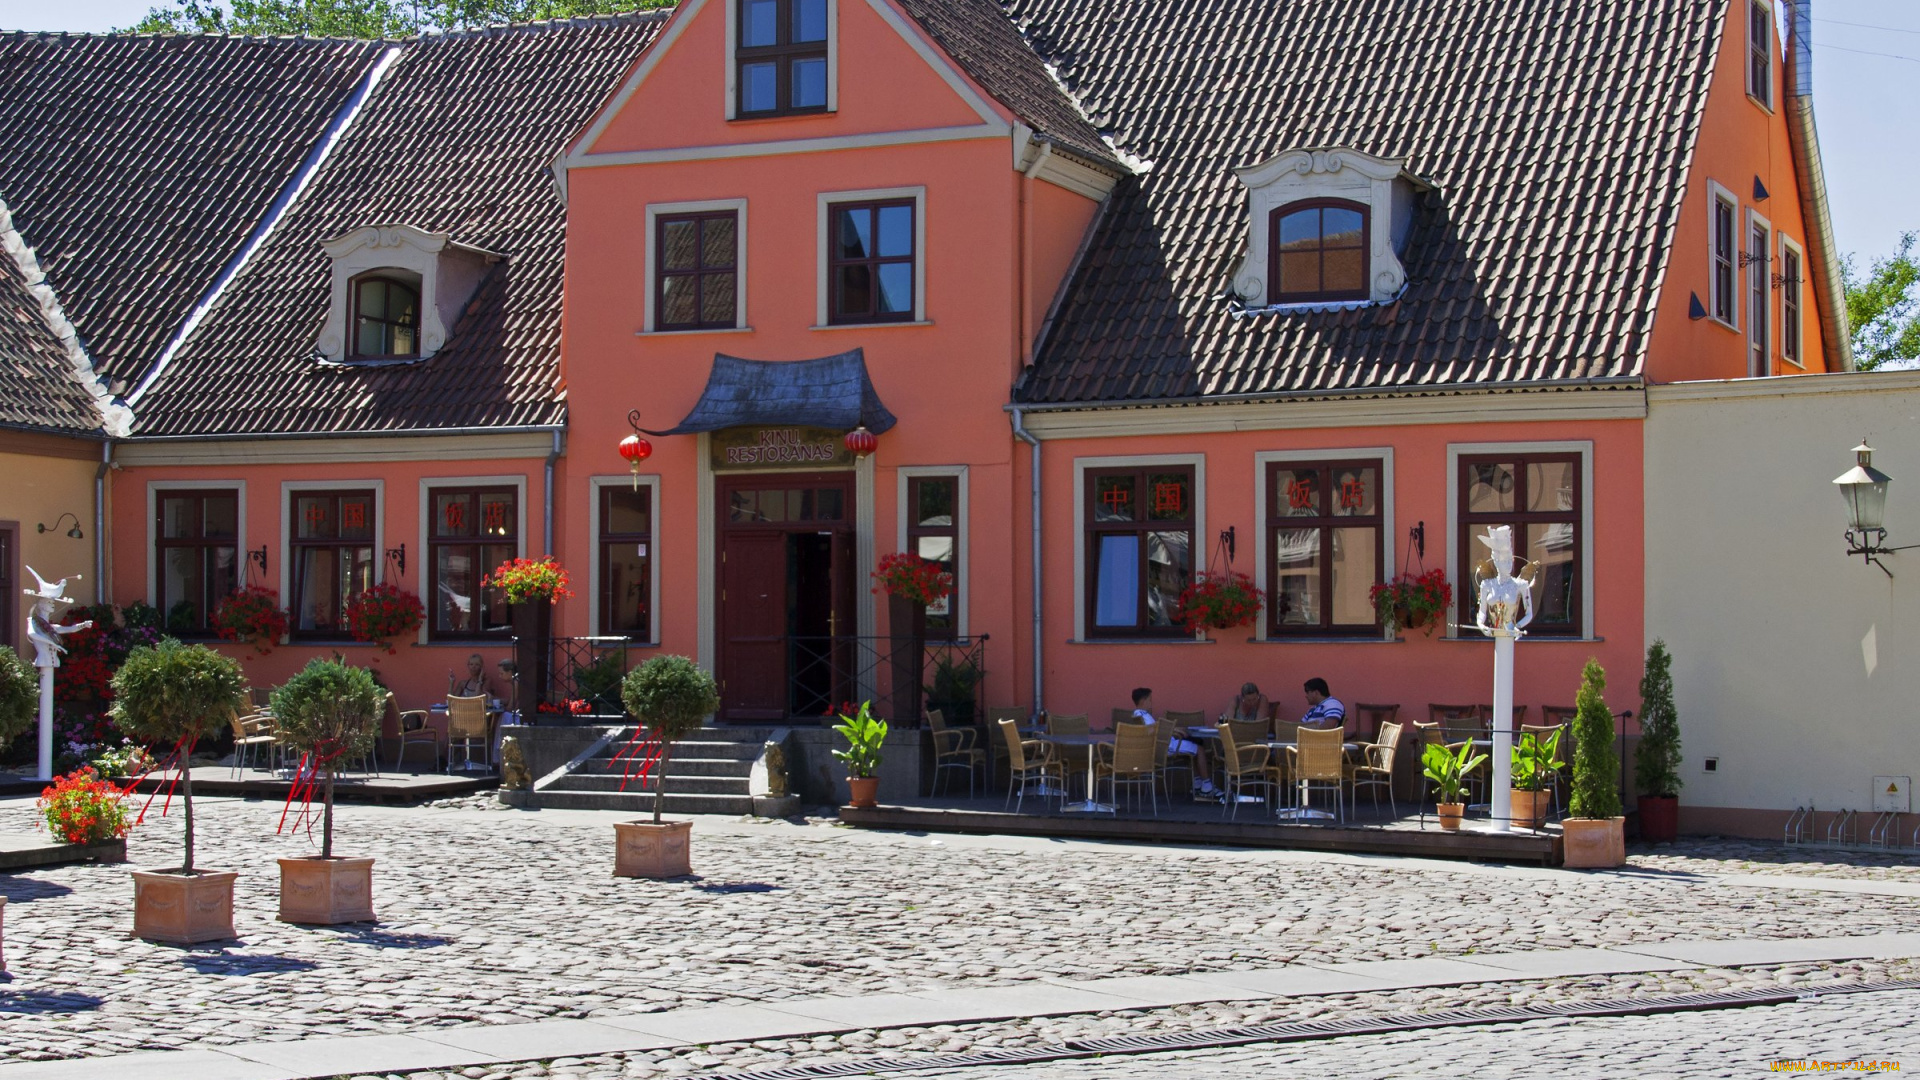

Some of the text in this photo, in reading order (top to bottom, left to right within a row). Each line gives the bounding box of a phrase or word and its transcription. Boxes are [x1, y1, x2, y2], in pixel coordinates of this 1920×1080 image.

[726, 443, 834, 463] RESTORANAS
[1103, 478, 1366, 515] 中国 饭店
[305, 502, 365, 529] 中国
